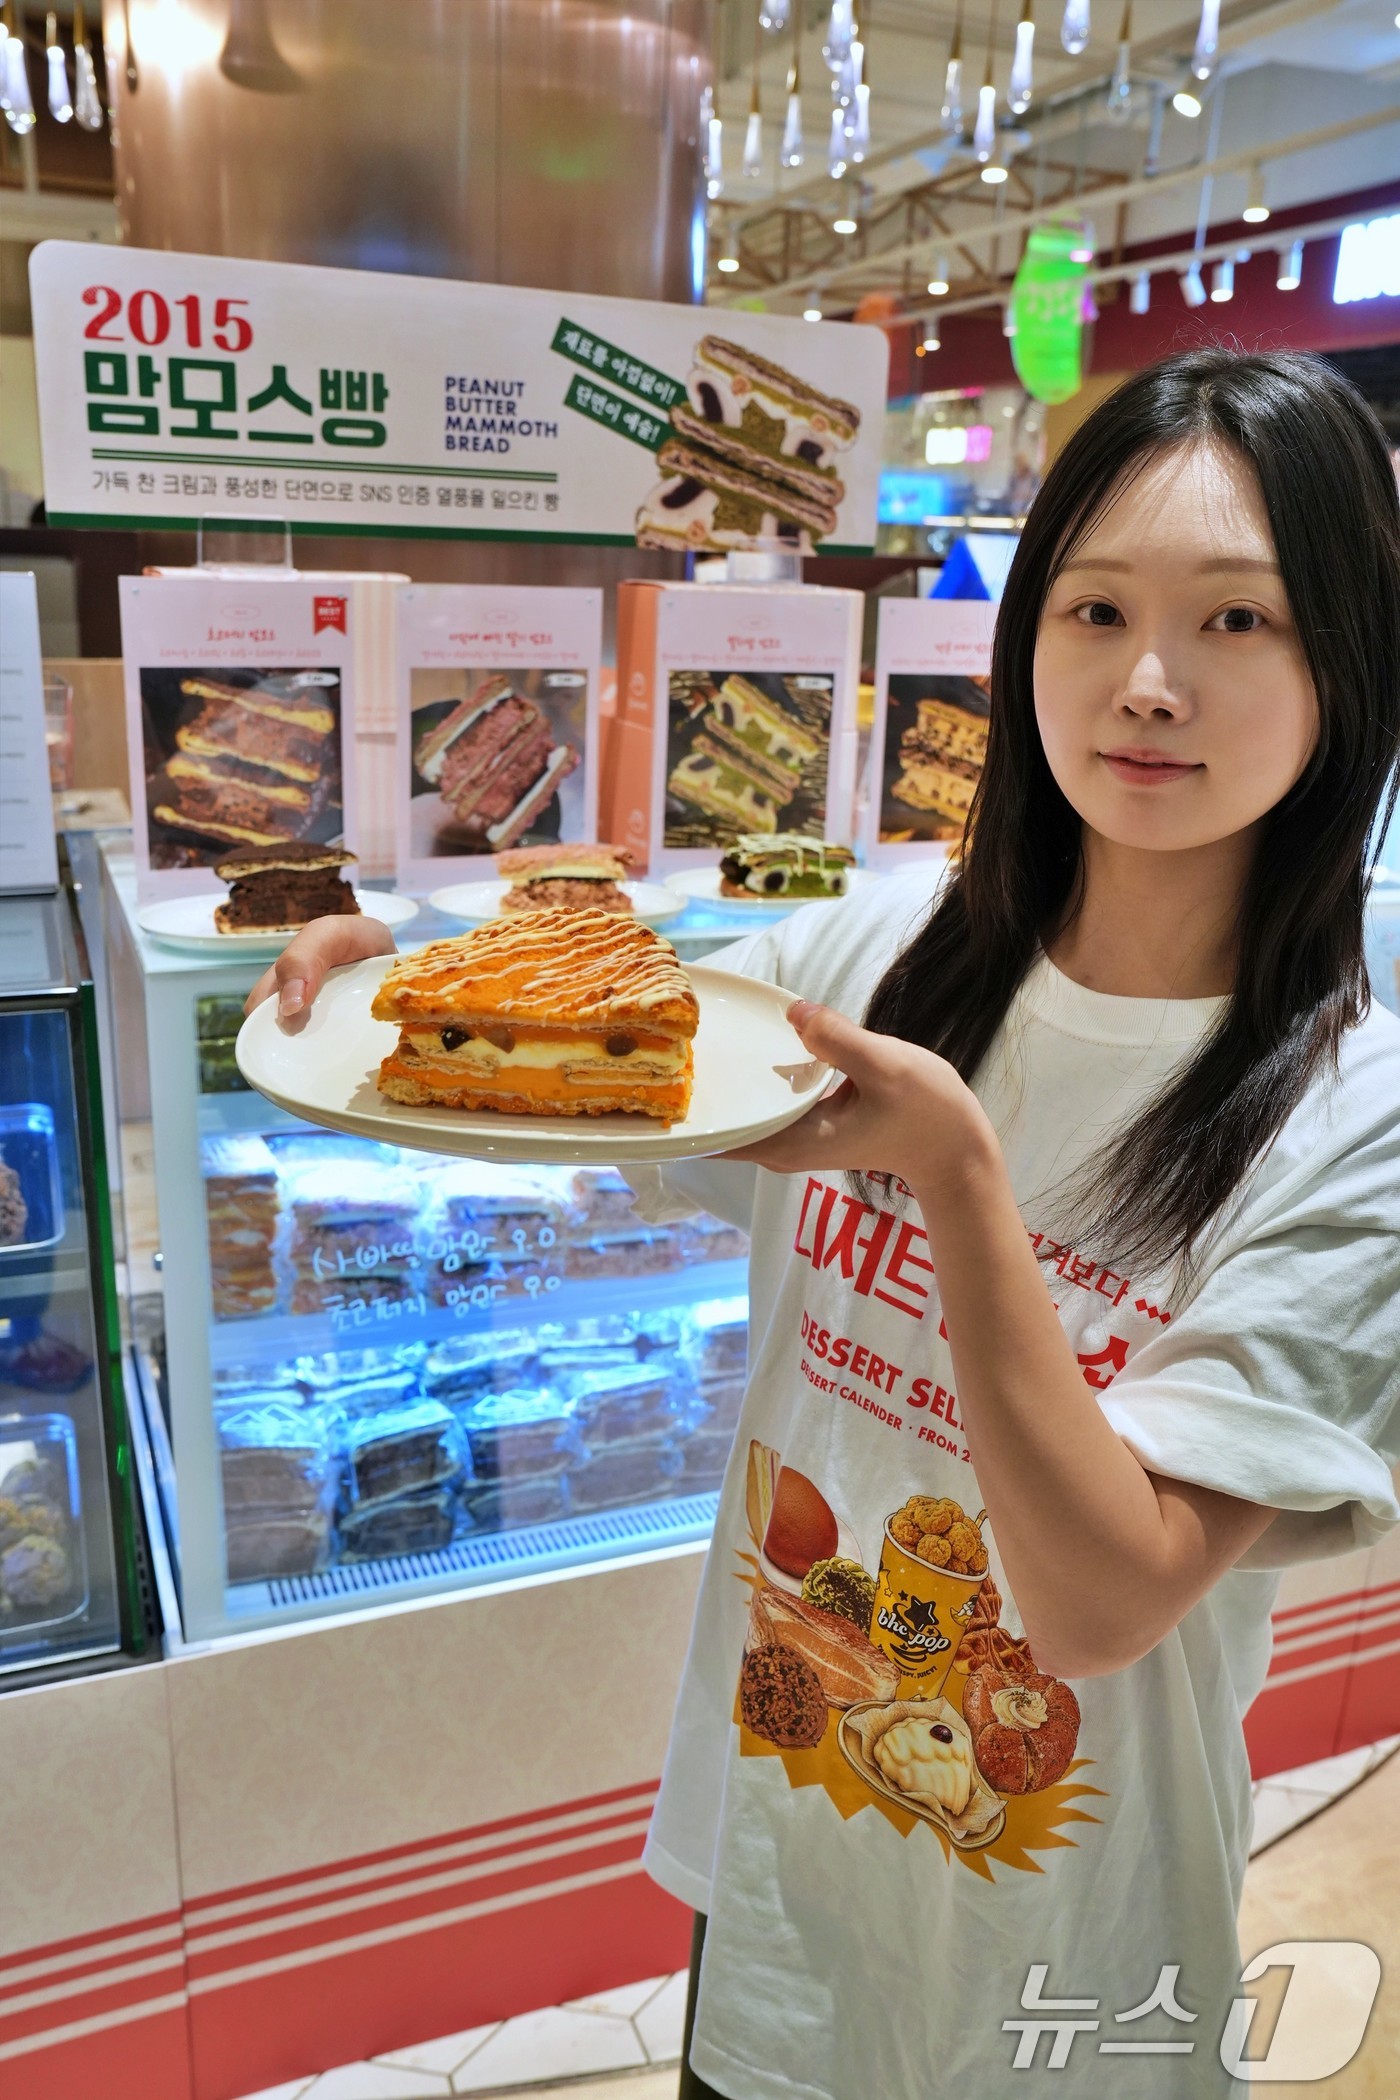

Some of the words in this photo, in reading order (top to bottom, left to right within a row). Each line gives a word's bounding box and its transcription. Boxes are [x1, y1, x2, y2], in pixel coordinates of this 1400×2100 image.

[82, 286, 253, 352] 2015
[446, 376, 525, 398] PEANUT
[561, 330, 609, 369] 재료를
[611, 358, 677, 405] 아낌없이!
[84, 351, 389, 448] 맘모스빵
[445, 416, 558, 438] MAMMOTH
[446, 396, 516, 416] BUTTER
[576, 384, 622, 423] 단면이
[623, 412, 661, 443] 예술!
[446, 435, 511, 453] BREAD
[92, 471, 130, 492] 가득
[137, 473, 155, 494] 찬
[163, 474, 218, 496] 크림과
[225, 476, 278, 499] 풍성한
[284, 478, 354, 502] 단면으로
[359, 484, 393, 503] SNS
[397, 485, 430, 506] 인증
[435, 486, 485, 508] 열풍을
[490, 488, 539, 511] 일으킨
[544, 490, 560, 512] 빵
[794, 1176, 936, 1321] 디저트
[800, 1310, 903, 1395] DESSERT
[906, 1377, 965, 1432] SEL
[839, 1386, 903, 1431] CALENDER
[917, 1426, 958, 1457] FROM
[961, 1449, 973, 1464] 2
[877, 1606, 909, 1636] bhc
[907, 1632, 951, 1653] pop
